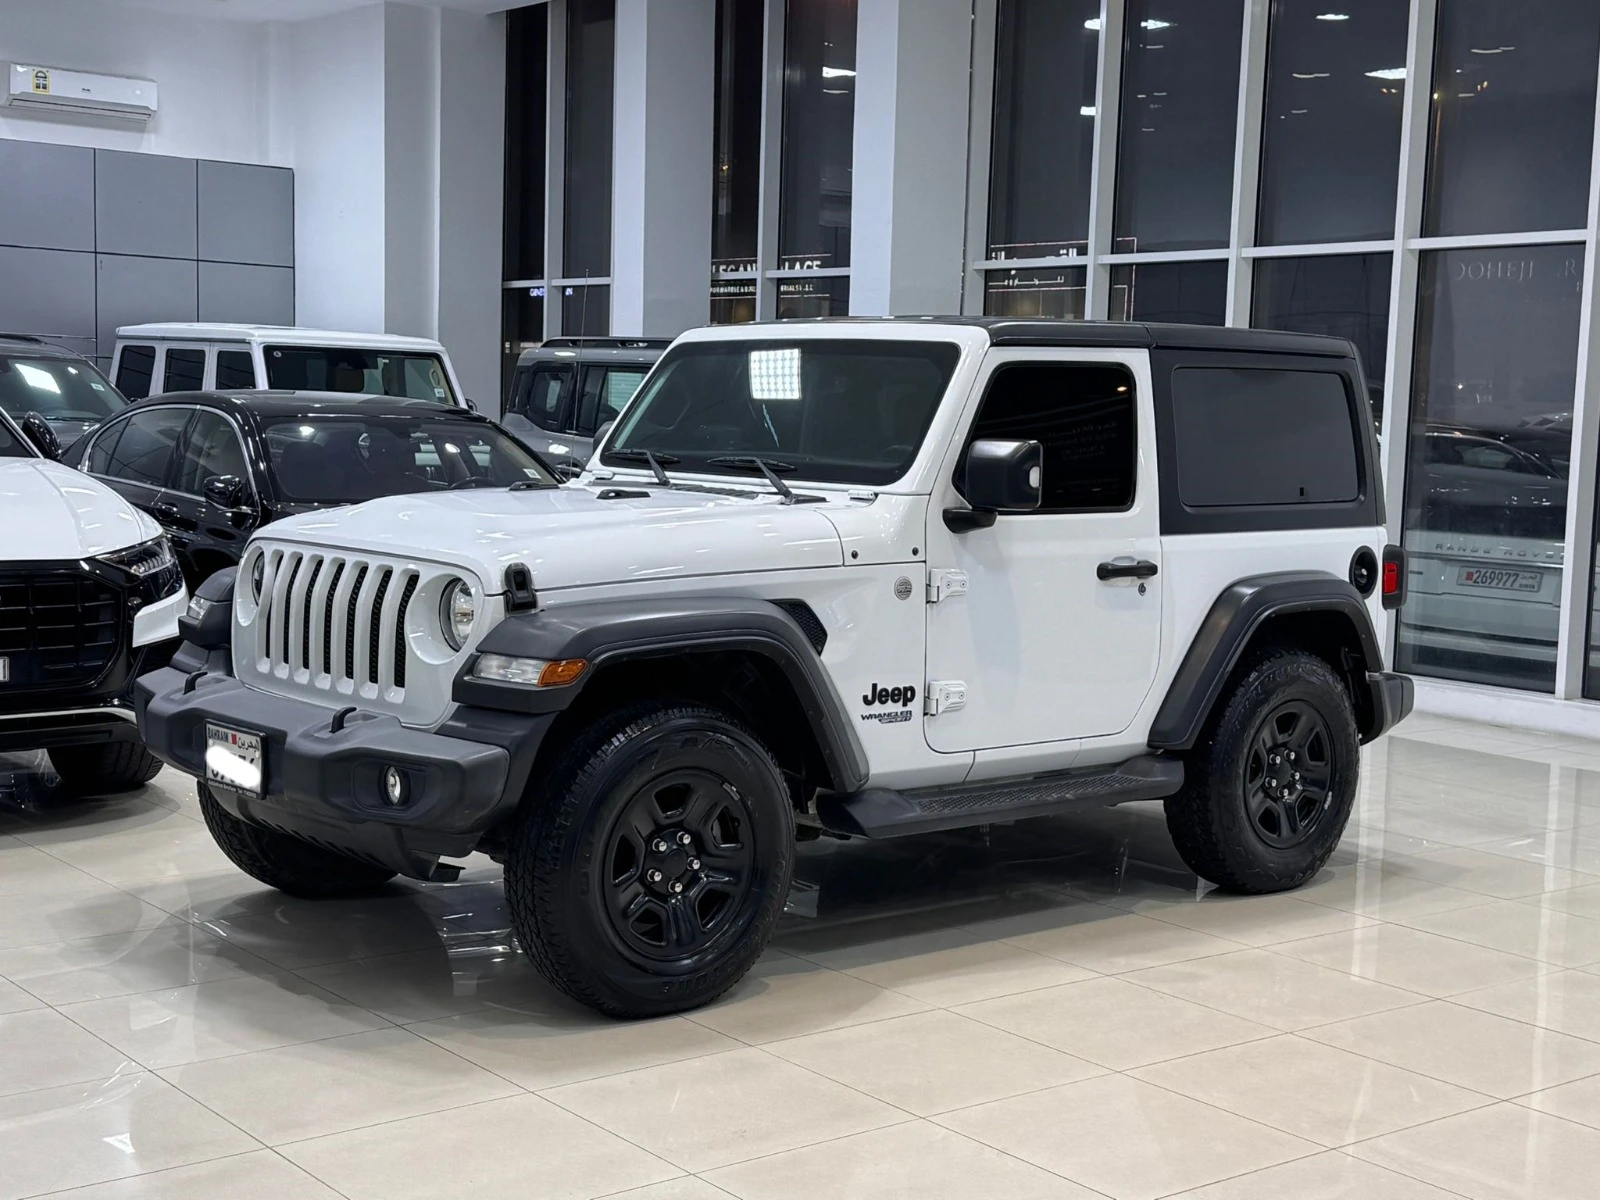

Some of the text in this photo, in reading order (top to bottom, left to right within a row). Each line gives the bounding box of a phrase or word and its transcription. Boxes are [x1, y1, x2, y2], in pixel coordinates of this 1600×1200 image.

[1473, 569, 1520, 587] 269977
[862, 683, 916, 707] Jeep
[861, 710, 912, 721] WRANGLER
[207, 726, 229, 743] BAHRAIN
[237, 737, 260, 753] البحرين
